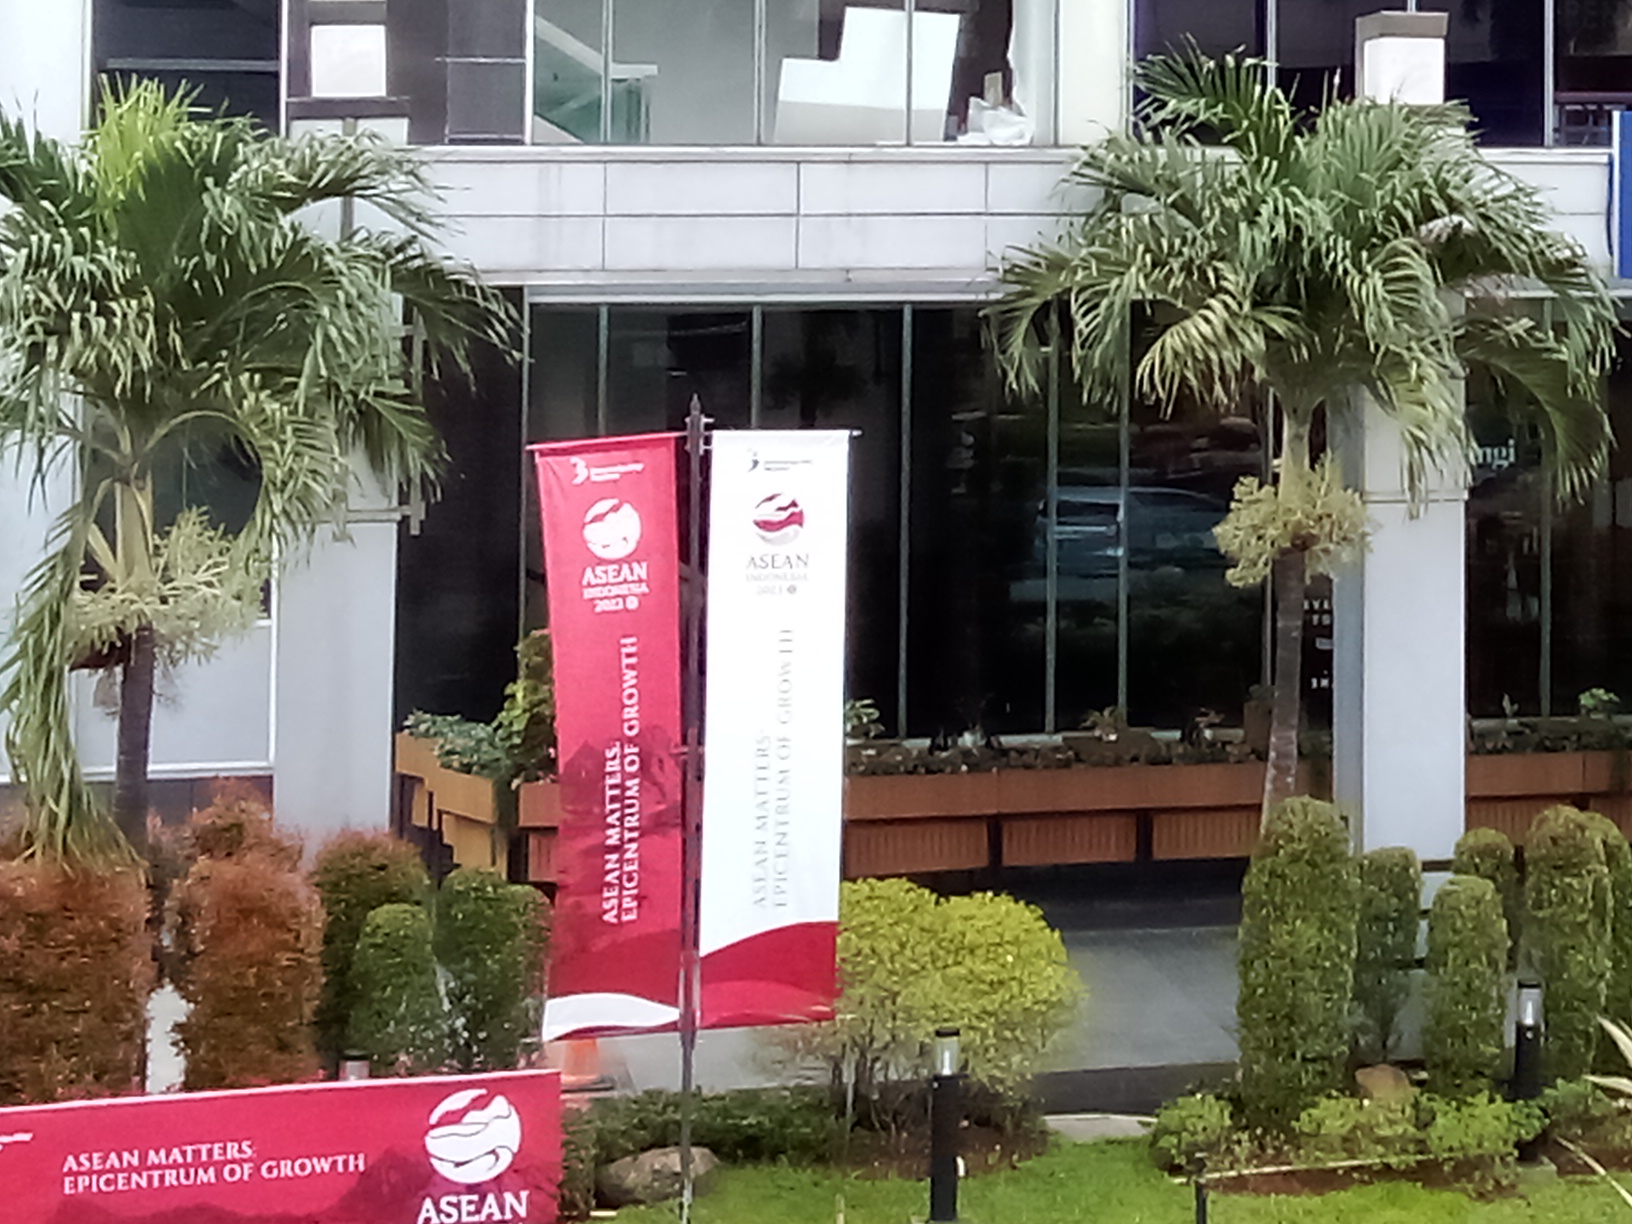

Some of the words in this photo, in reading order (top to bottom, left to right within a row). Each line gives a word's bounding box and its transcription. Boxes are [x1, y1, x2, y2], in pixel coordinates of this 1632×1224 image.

[582, 562, 648, 586] ASEAN
[746, 553, 809, 570] ASEAN
[620, 635, 639, 737] GROWTH
[776, 628, 794, 725] GROWTH
[623, 743, 640, 773] OF
[775, 734, 792, 761] OF
[621, 779, 640, 922] EPICENTRUM
[773, 768, 792, 908] EPICENTRUM
[602, 854, 620, 924] ASEAN
[752, 840, 768, 908] ASEAN
[62, 1148, 143, 1172] ASEAN
[62, 1167, 217, 1195] EPICENTRUM
[223, 1162, 255, 1184] OF
[261, 1153, 366, 1181] GROWTH
[417, 1190, 530, 1224] ASEAN
